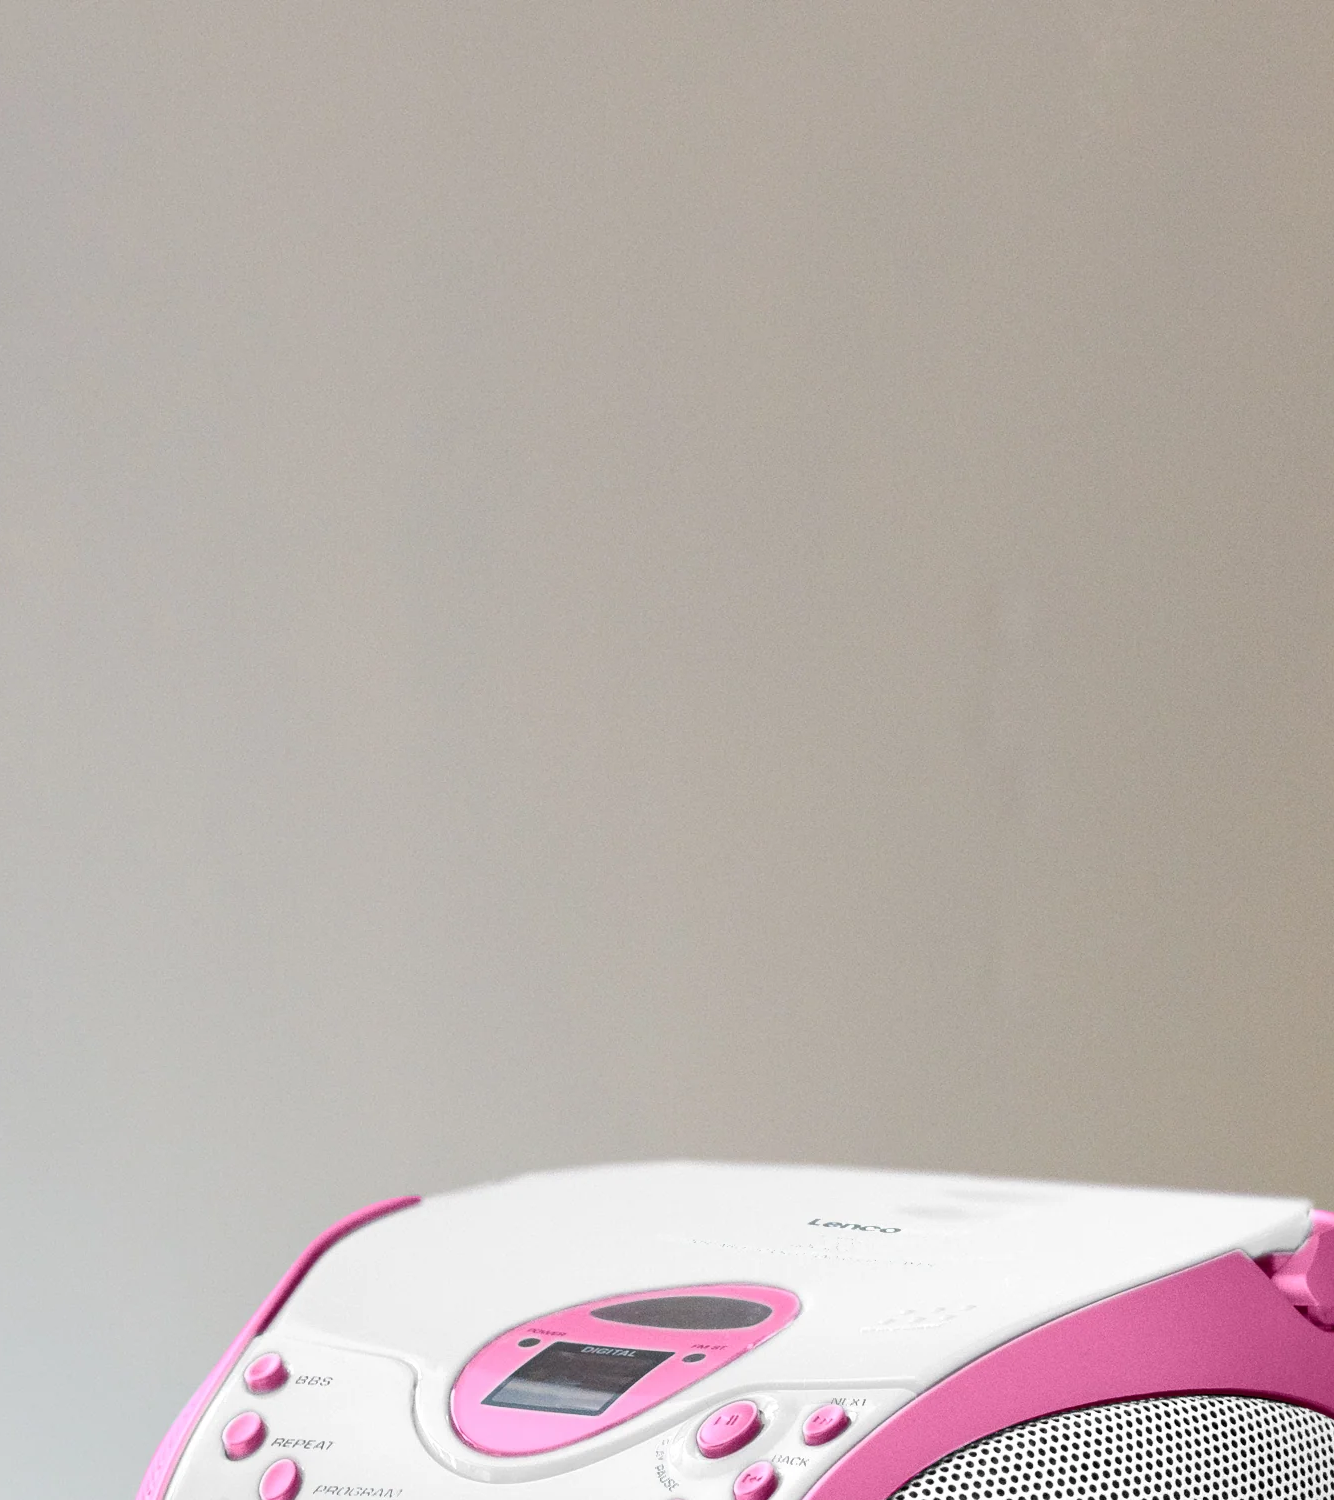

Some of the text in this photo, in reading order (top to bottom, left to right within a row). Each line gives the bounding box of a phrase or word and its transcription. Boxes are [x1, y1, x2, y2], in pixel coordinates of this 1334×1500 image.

[806, 1217, 902, 1234] Lenco
[527, 1327, 567, 1337] POWER
[580, 1345, 637, 1358] DIGITAL
[295, 1375, 333, 1387] BBS
[270, 1437, 335, 1451] REPEAT
[771, 1454, 810, 1468] BACK
[312, 1484, 403, 1499] PROGRAM
